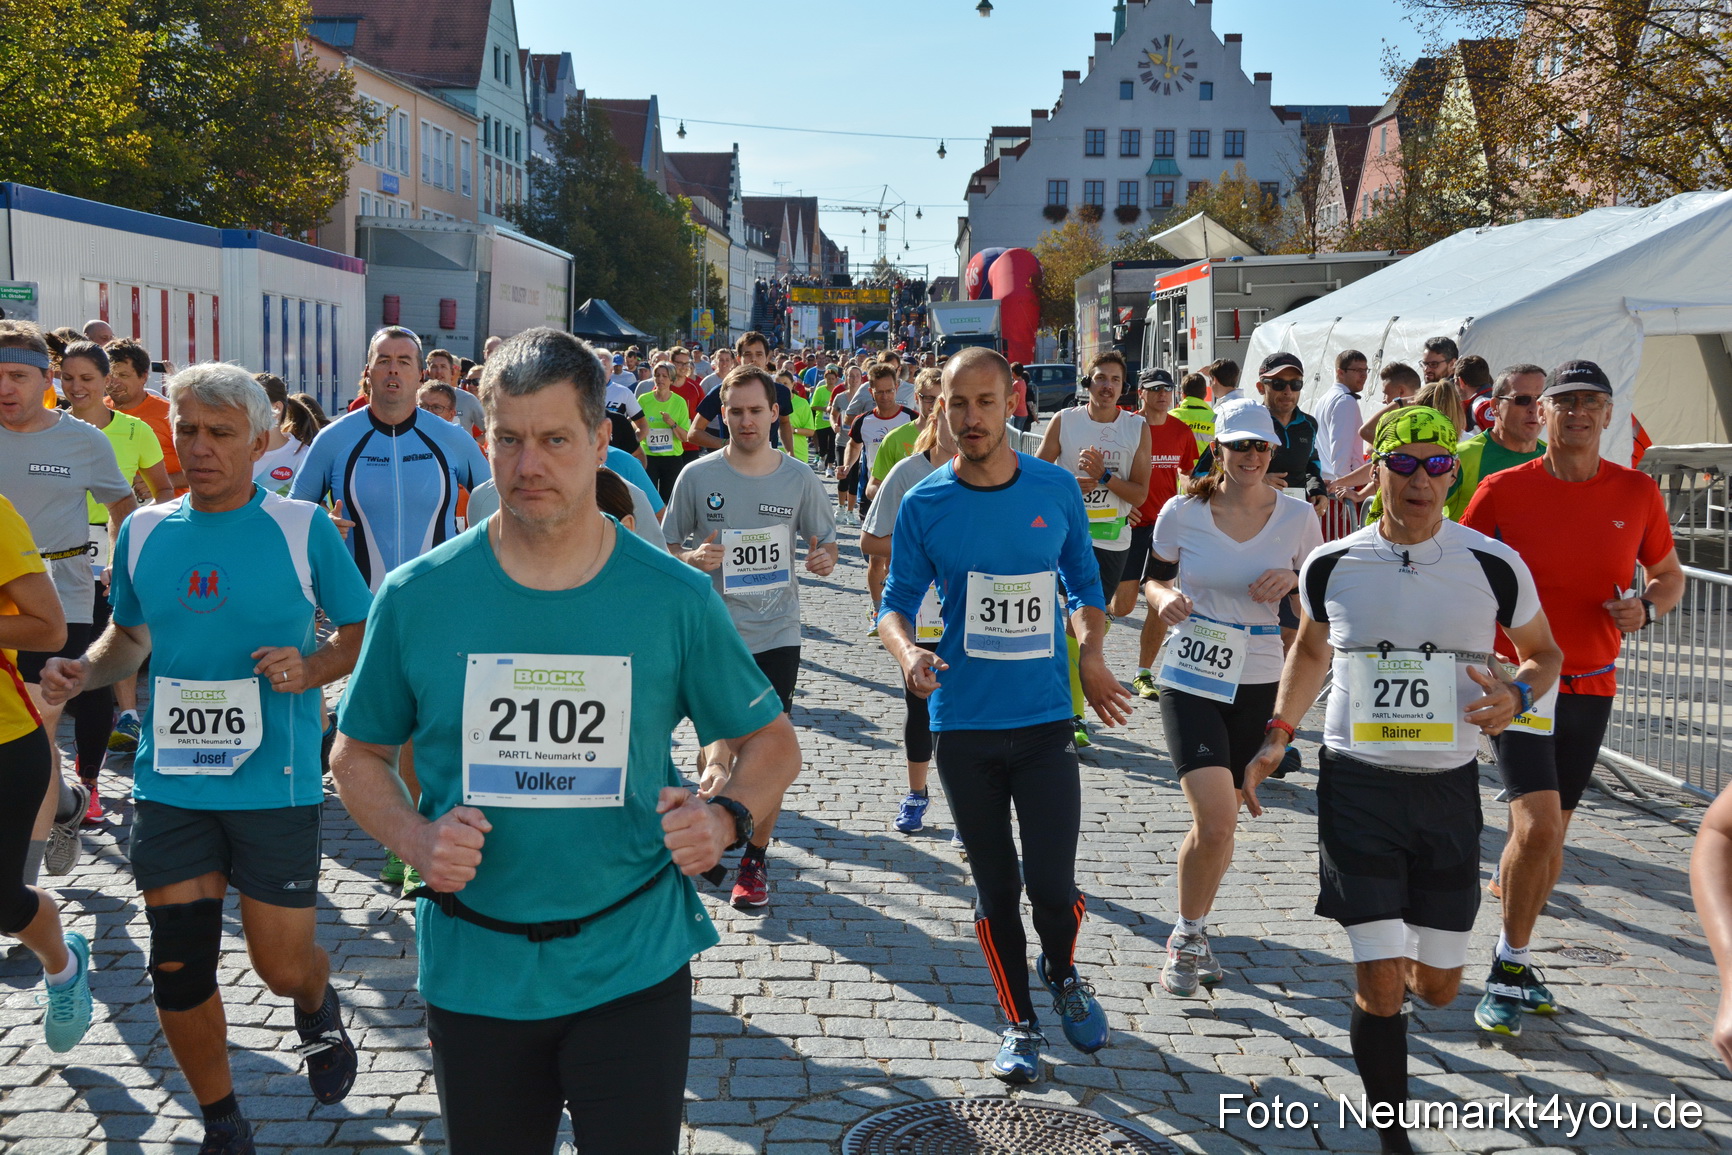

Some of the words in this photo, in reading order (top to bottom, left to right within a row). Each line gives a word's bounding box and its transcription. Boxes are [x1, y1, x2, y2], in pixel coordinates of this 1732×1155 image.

[823, 291, 858, 300] START
[650, 434, 670, 444] 2170
[28, 463, 71, 476] BOCK
[1083, 489, 1109, 504] 327
[759, 503, 793, 516] BOCK
[741, 532, 771, 542] BOCK
[732, 543, 780, 566] 3015
[742, 572, 778, 585] CHRIS
[993, 582, 1031, 593] BOCK
[979, 597, 1041, 624] 3116
[984, 626, 1004, 634] PARTL
[1005, 626, 1030, 634] Neumarkt
[1193, 625, 1227, 641] BOCK
[1177, 636, 1233, 670] 3043
[1178, 661, 1194, 671] PARTL
[1194, 666, 1217, 676] Neumarkt
[1377, 660, 1424, 671] BOCK
[513, 669, 585, 686] BOCK
[181, 689, 227, 700] BOCK
[1373, 678, 1430, 708] 276
[169, 707, 246, 735] 2076
[489, 697, 606, 744] 2102
[473, 732, 479, 740] C
[1382, 726, 1421, 739] Rainer
[193, 751, 227, 764] Josef
[499, 750, 532, 759] PARTL
[534, 751, 581, 761] Neumarkt
[515, 770, 576, 791] Volker
